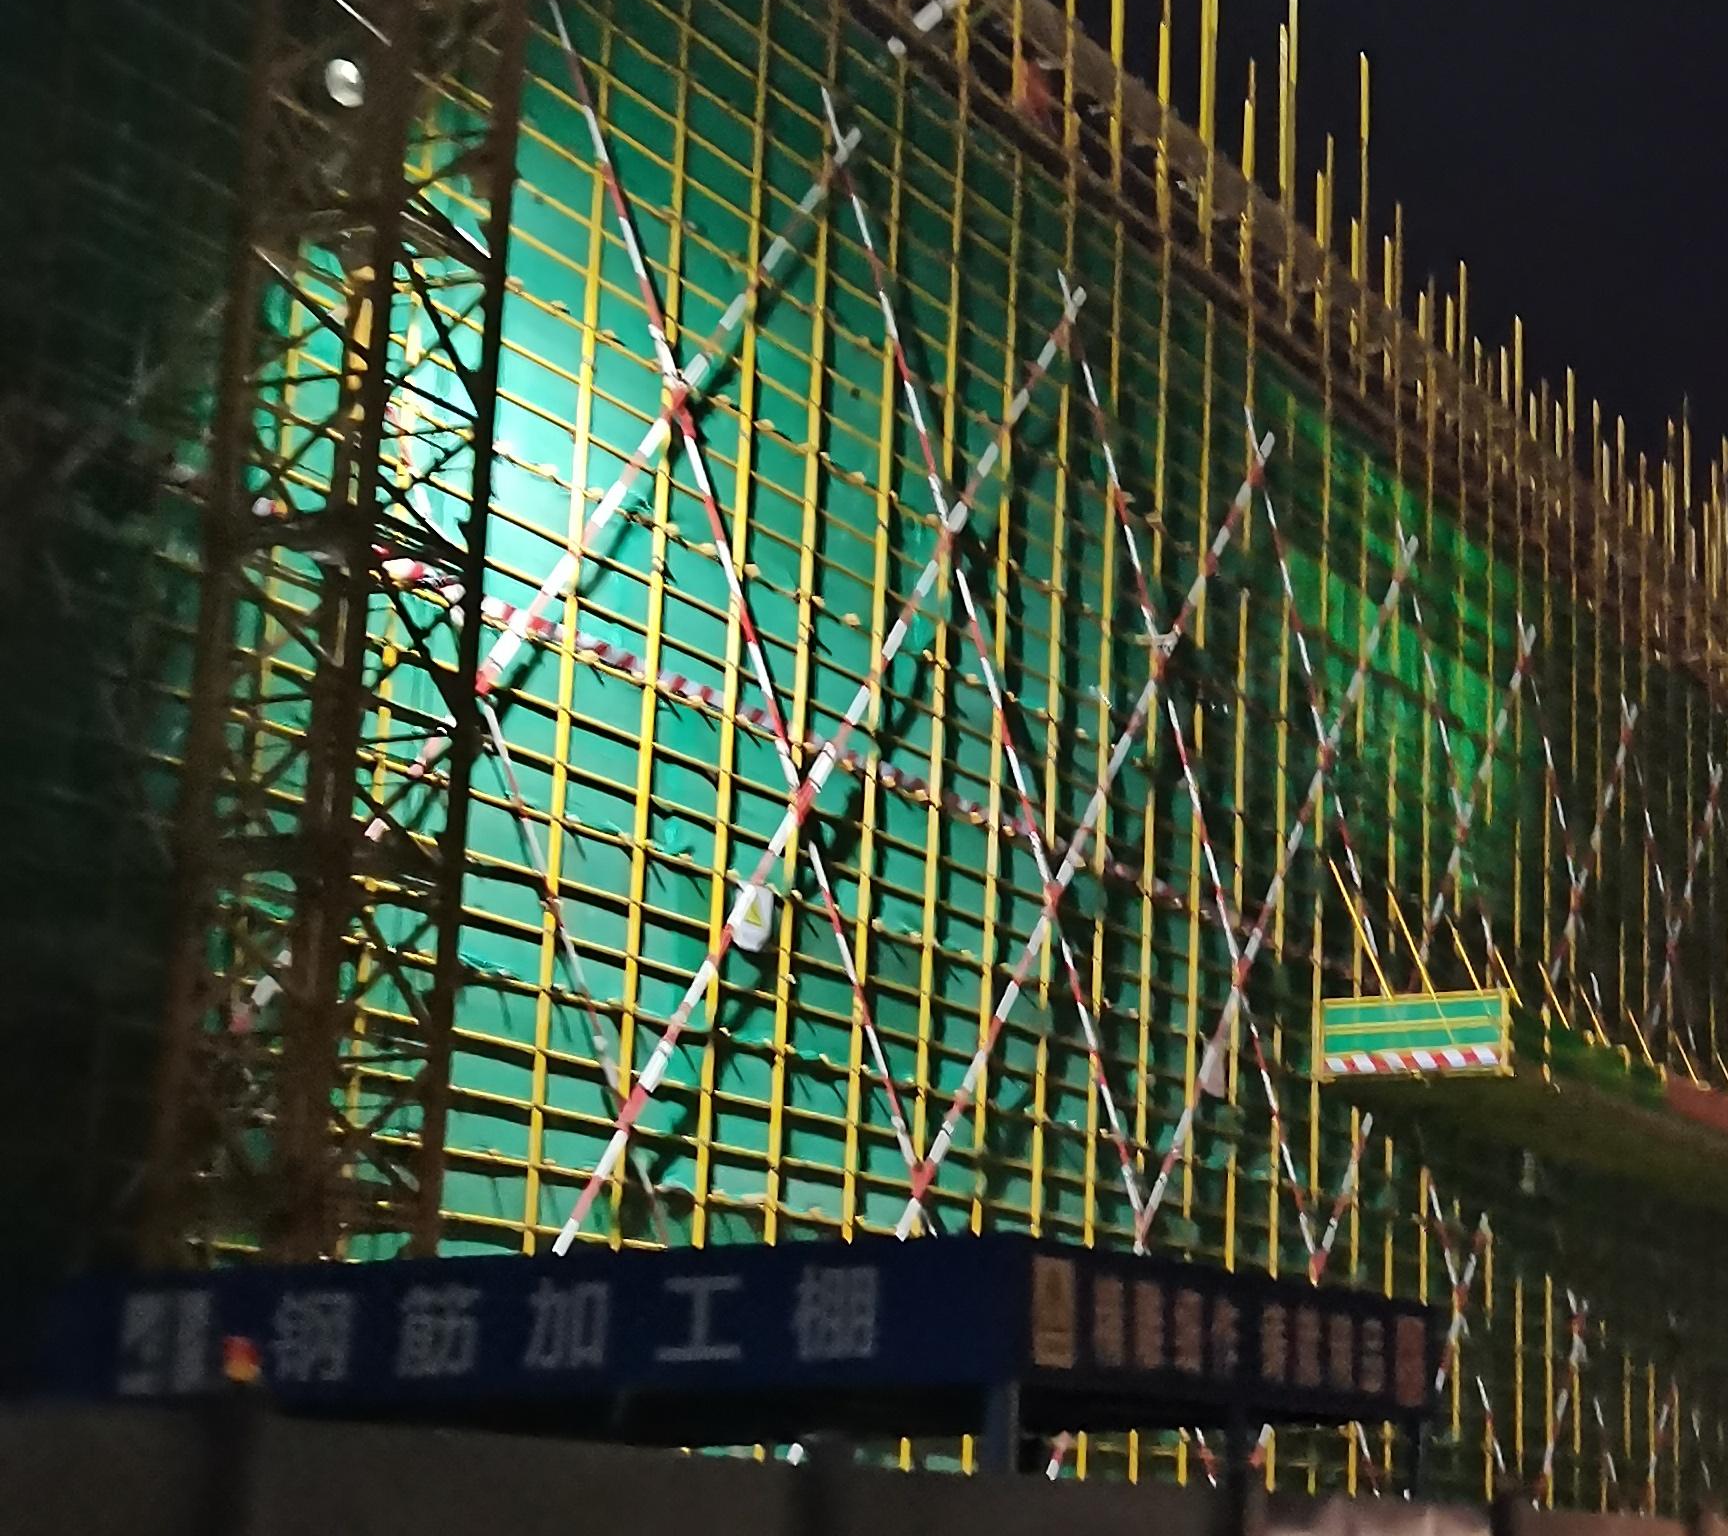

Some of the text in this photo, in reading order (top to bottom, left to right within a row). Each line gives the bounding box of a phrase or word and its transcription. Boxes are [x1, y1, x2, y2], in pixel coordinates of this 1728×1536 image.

[270, 1265, 880, 1381] 钢筋加工棚
